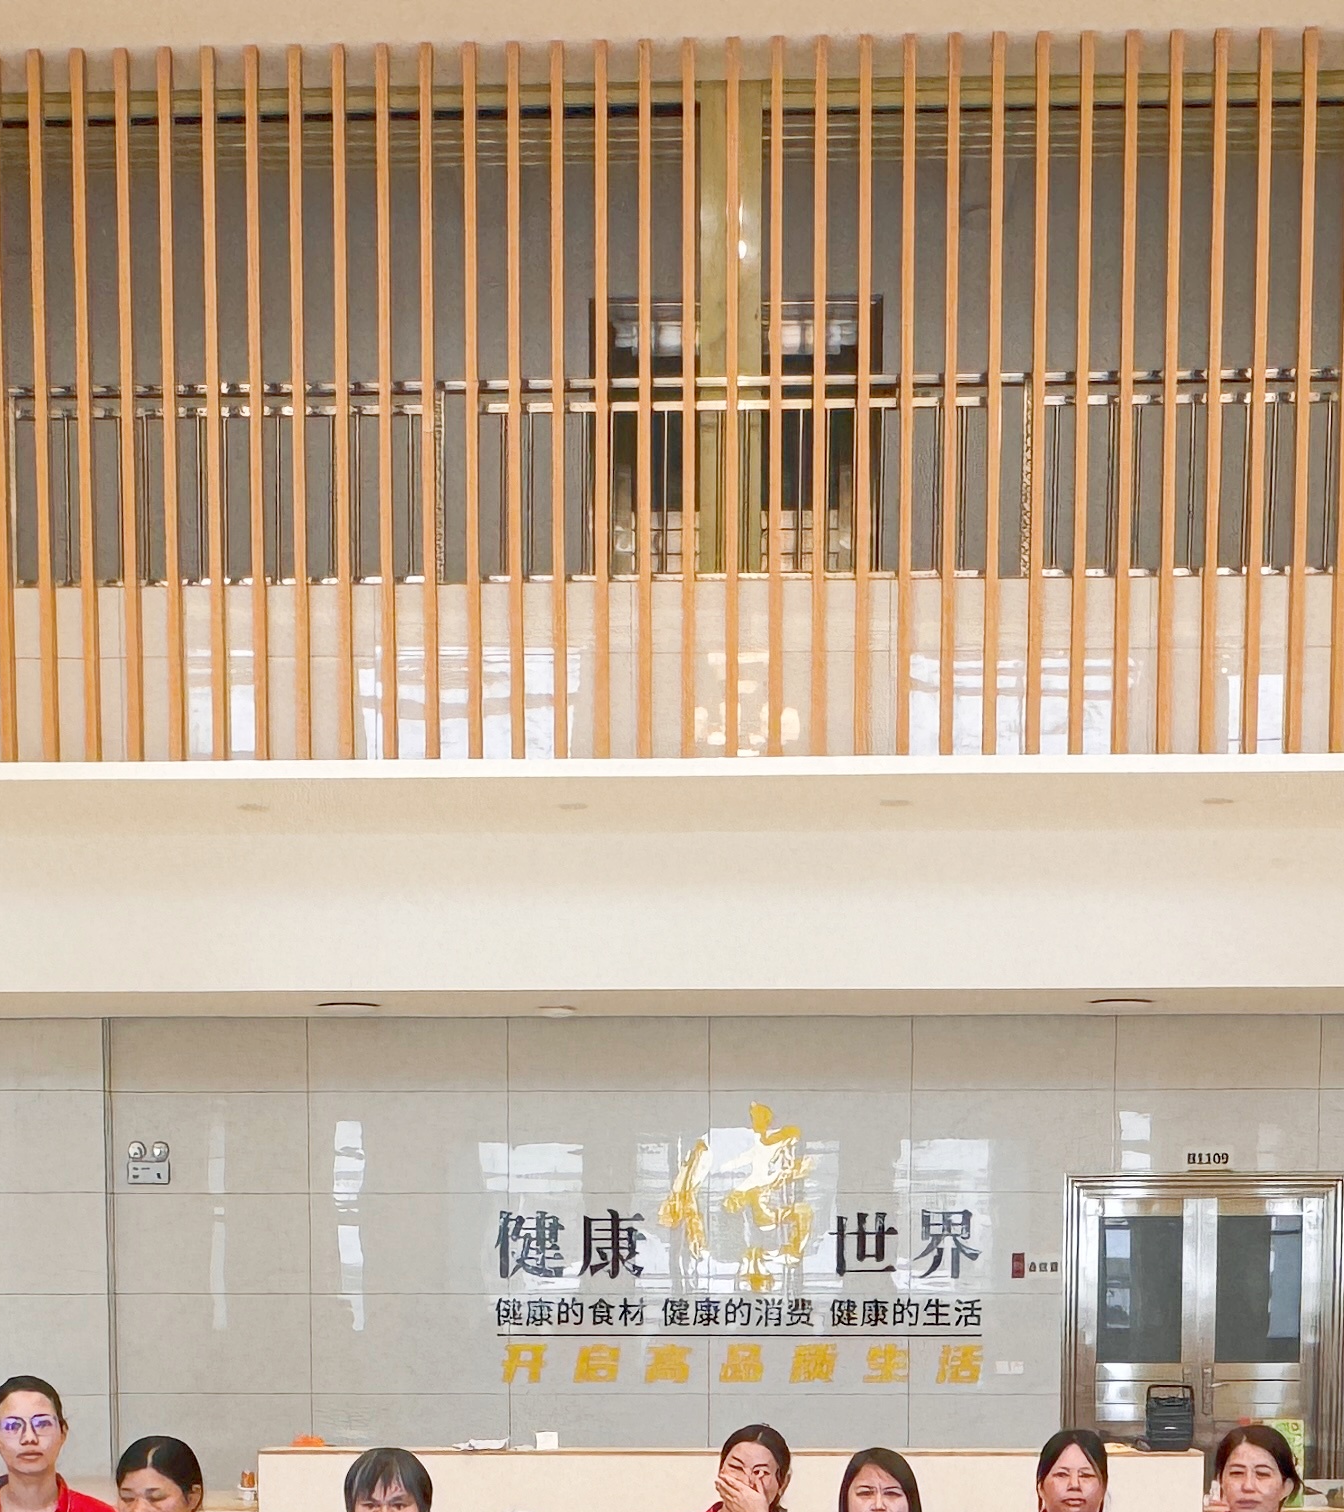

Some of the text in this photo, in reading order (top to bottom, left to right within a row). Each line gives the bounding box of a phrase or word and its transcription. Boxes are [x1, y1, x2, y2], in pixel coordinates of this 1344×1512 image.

[494, 1208, 982, 1279] 健康 世界
[495, 1297, 983, 1328] 健康的食材 健康的消费 健康的生活
[501, 1342, 985, 1385] 开启高品质生活
